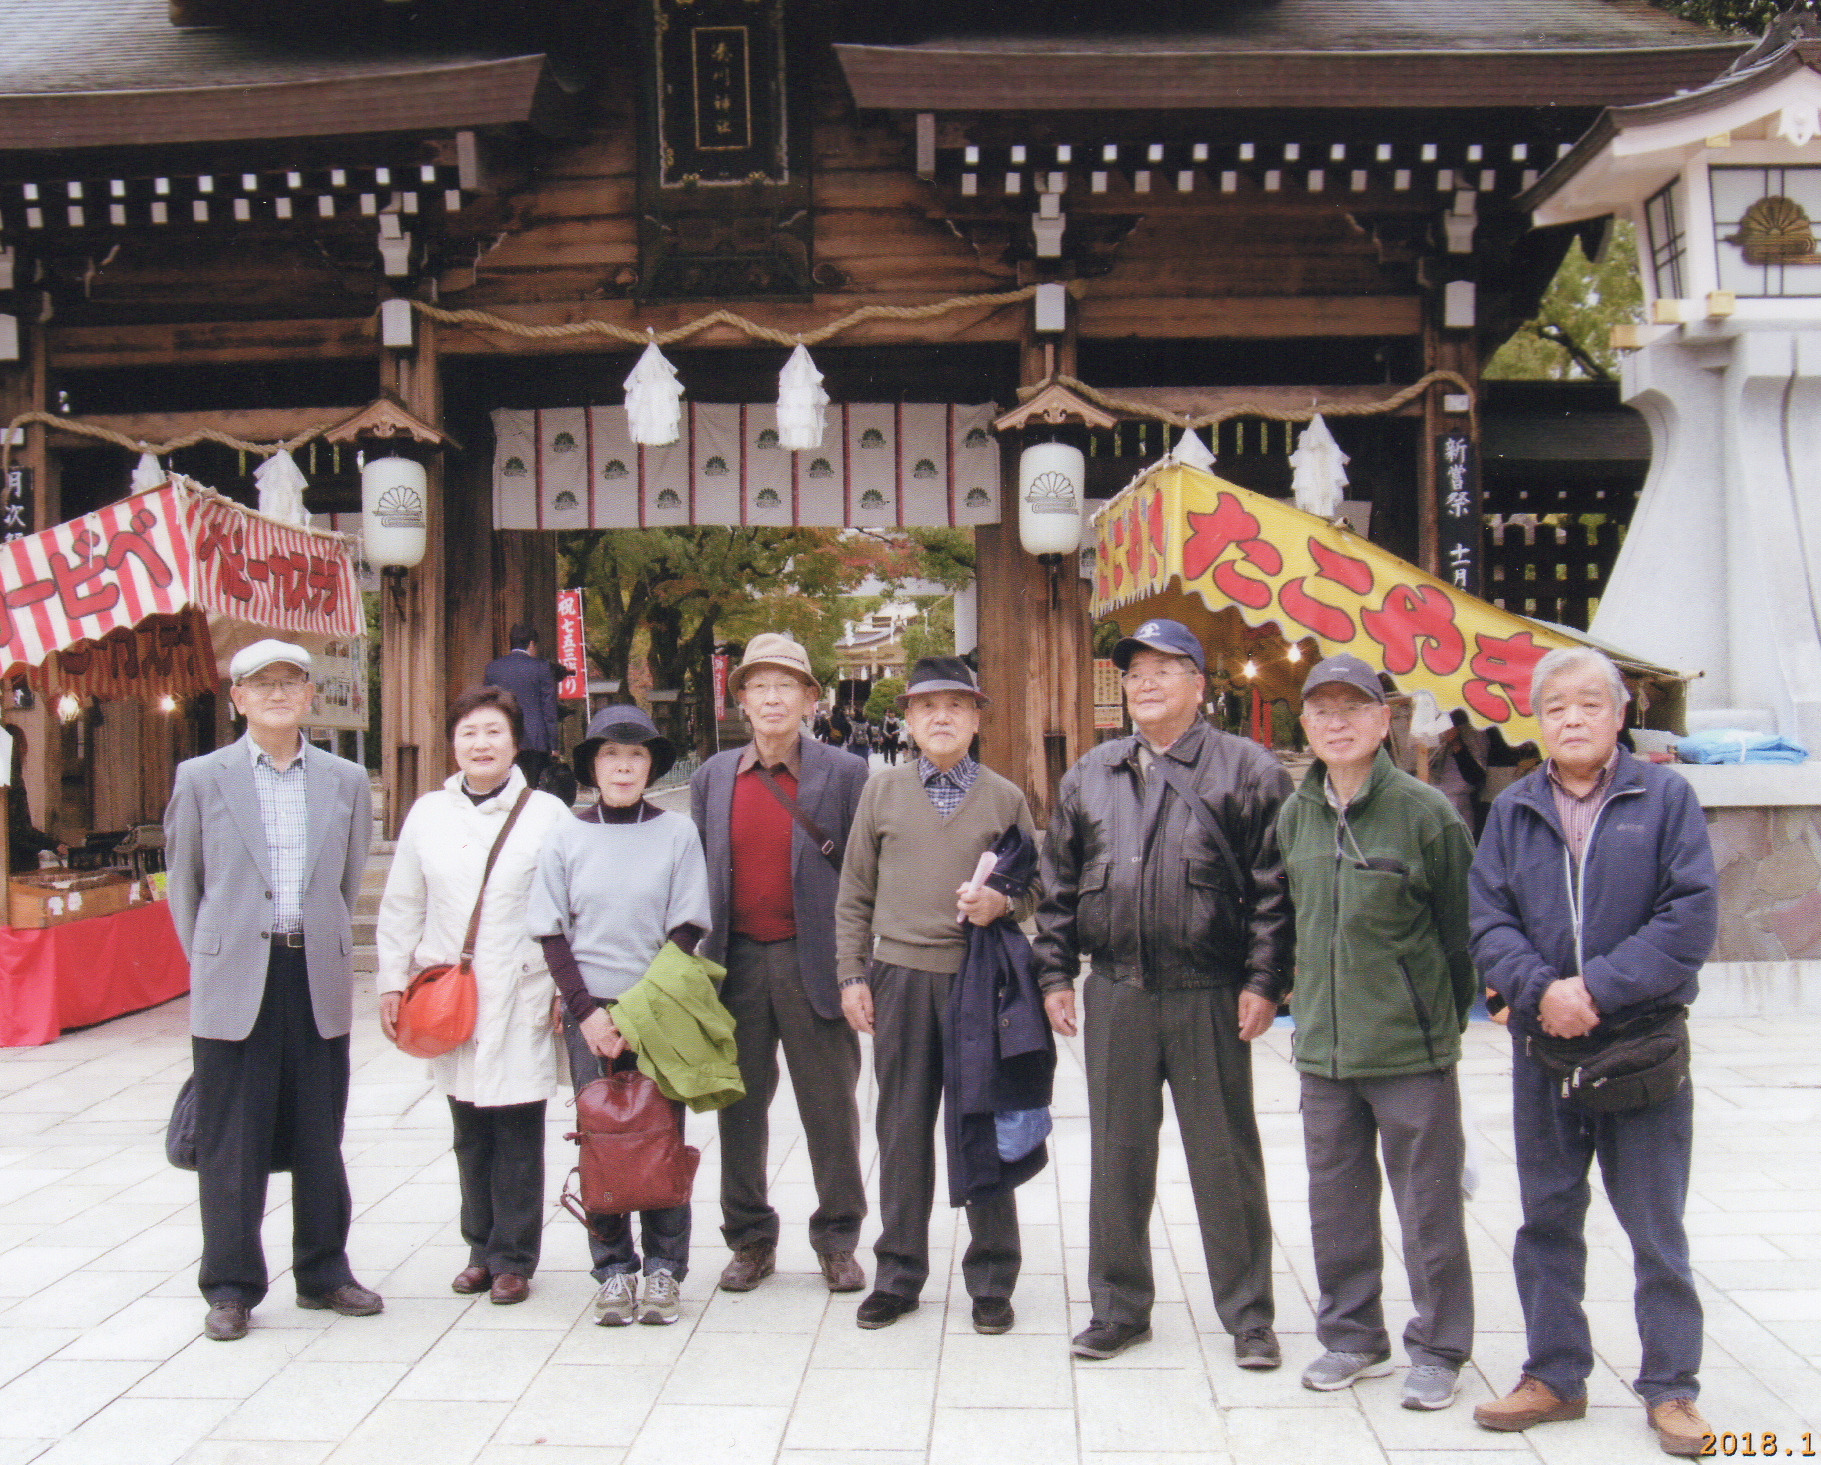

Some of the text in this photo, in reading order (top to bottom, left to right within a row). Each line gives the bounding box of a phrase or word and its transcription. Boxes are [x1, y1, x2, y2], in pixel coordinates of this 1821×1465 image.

[1183, 491, 1553, 723] たこやき
[1445, 437, 1472, 591] 新嘗祭 十一月
